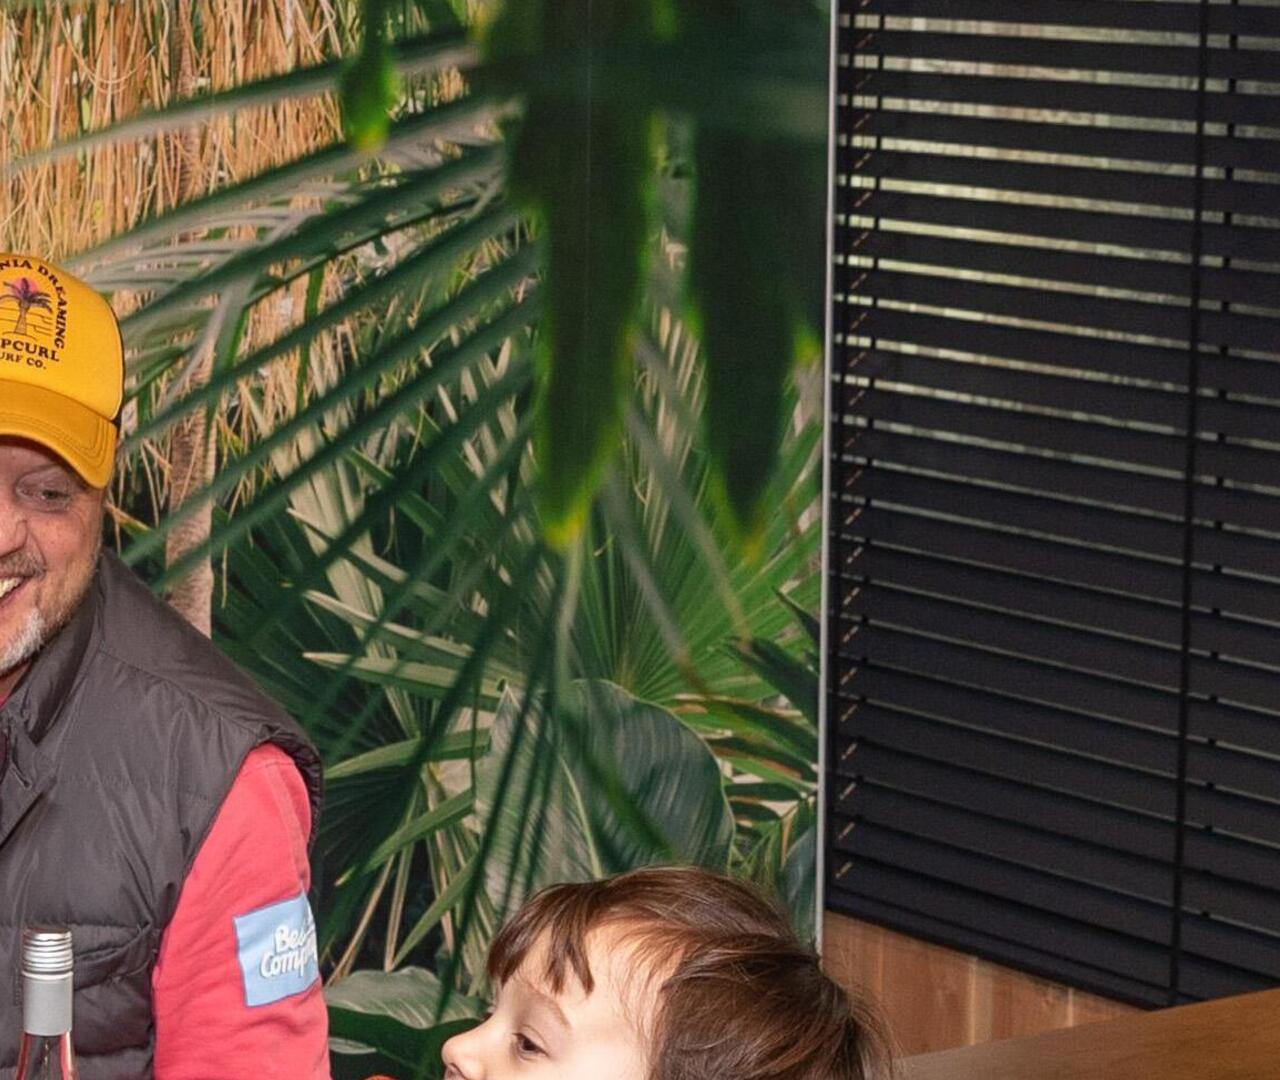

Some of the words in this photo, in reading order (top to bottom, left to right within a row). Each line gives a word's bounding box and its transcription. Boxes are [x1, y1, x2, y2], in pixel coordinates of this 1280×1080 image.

[37, 265, 67, 349] DREAMING
[26, 357, 47, 369] CO.
[260, 932, 318, 978] Comp
